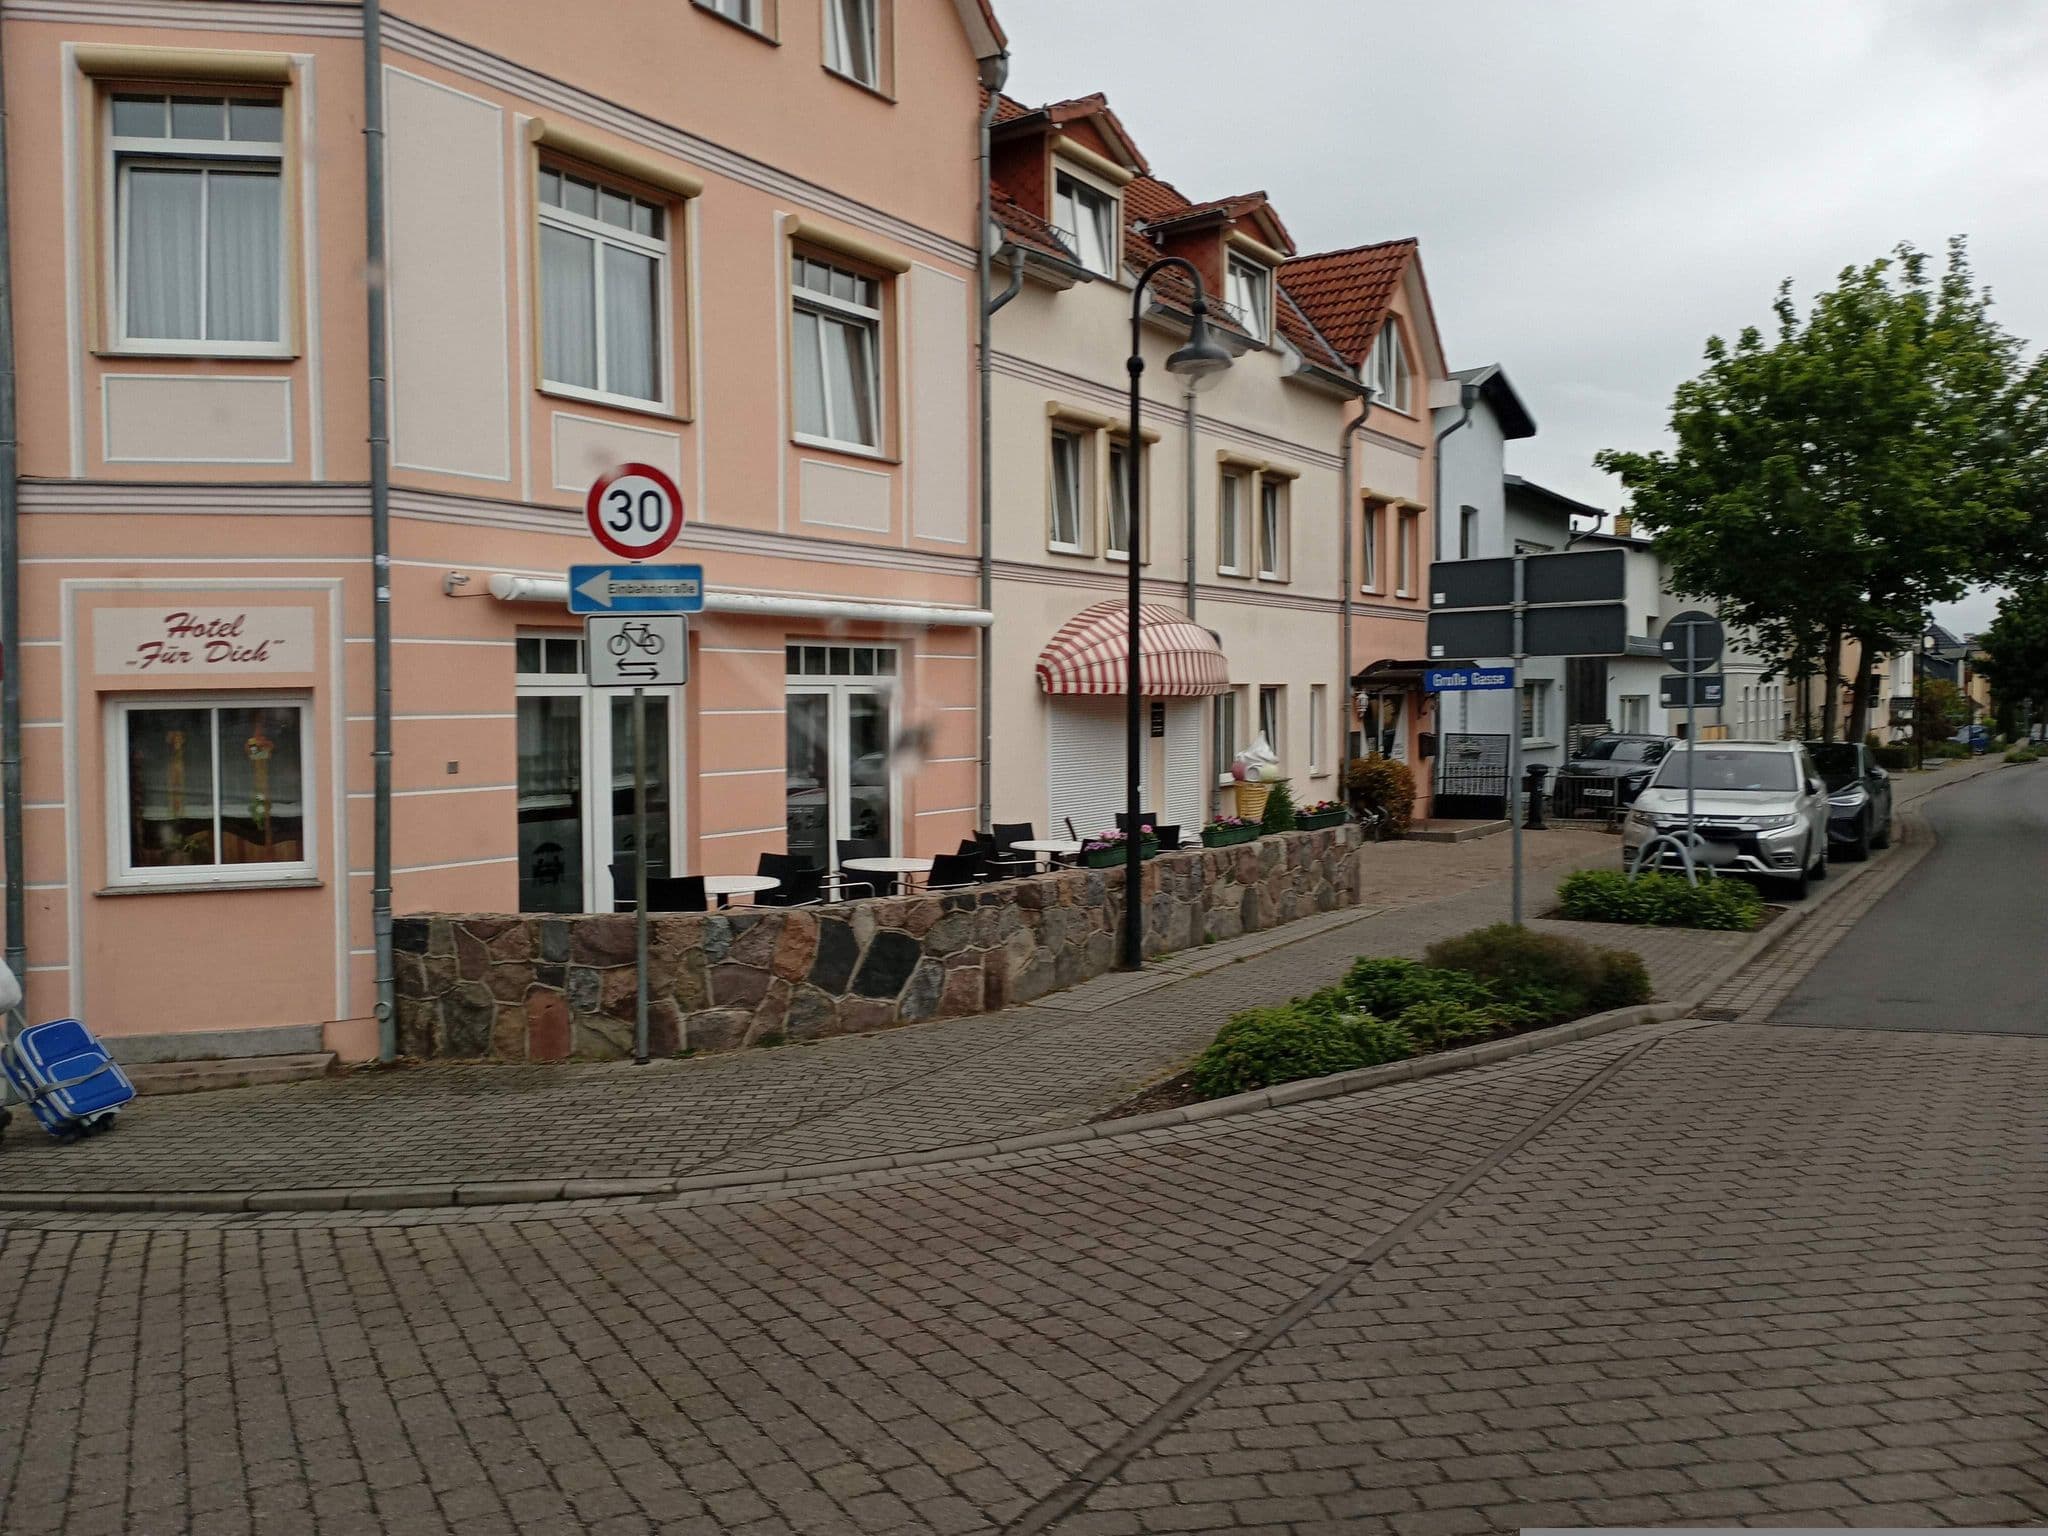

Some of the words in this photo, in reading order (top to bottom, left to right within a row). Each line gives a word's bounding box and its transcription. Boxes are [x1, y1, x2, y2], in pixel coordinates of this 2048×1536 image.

[608, 490, 662, 532] 30
[608, 583, 695, 594] Einbahnstraße
[163, 611, 247, 638] Hotel
[1432, 673, 1468, 687] Große
[1471, 672, 1506, 685] Gasse
